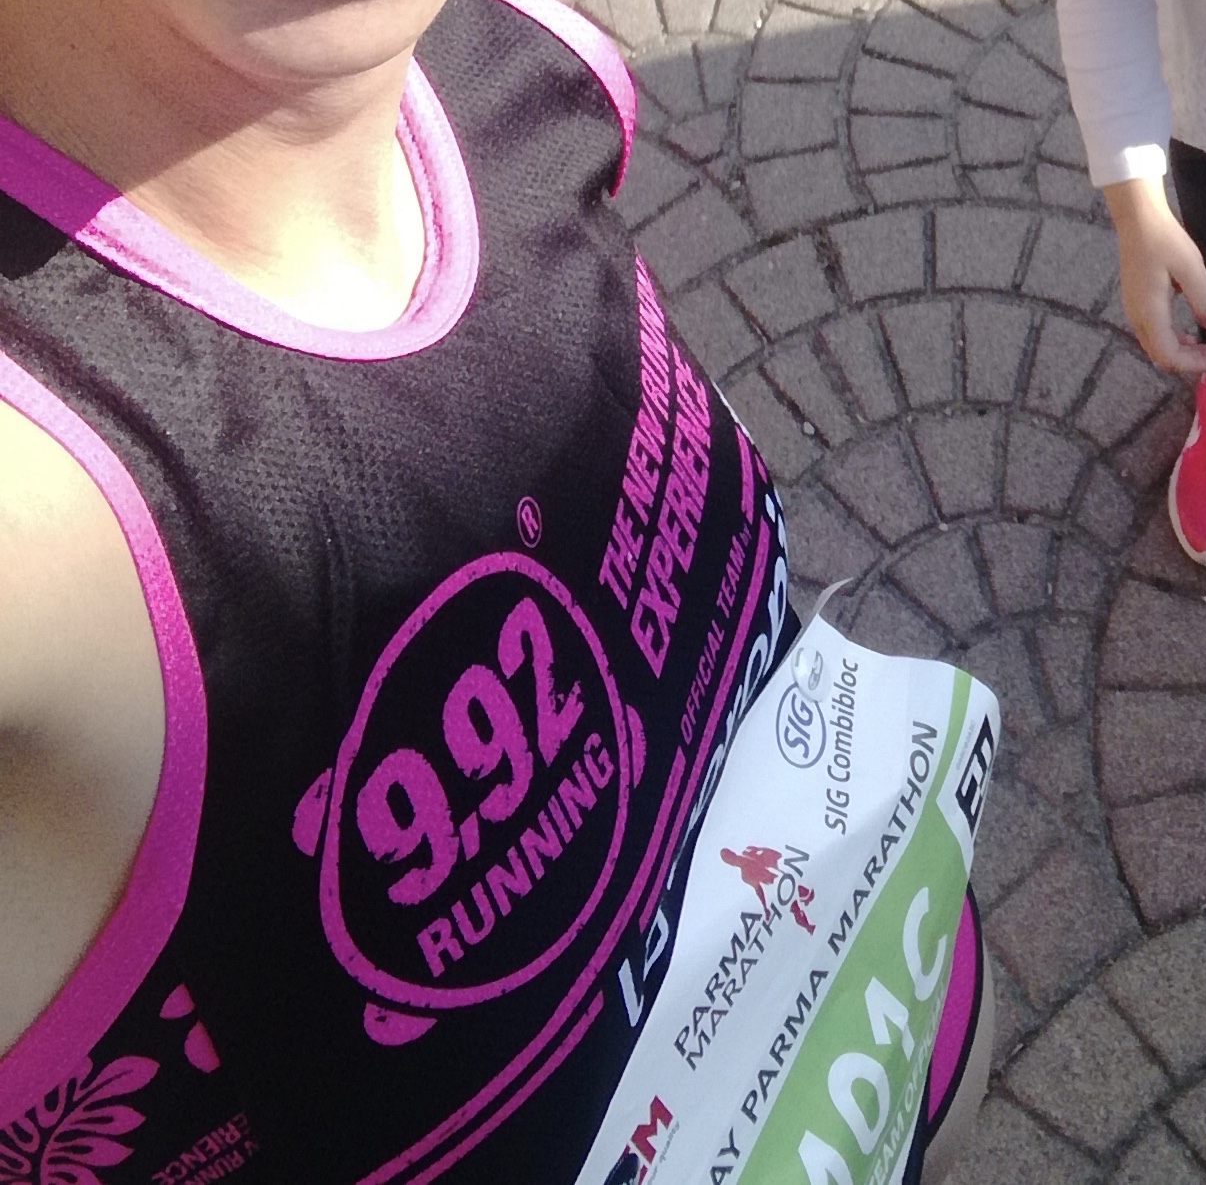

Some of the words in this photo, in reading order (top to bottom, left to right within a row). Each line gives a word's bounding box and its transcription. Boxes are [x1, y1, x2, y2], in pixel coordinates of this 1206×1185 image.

[634, 250, 669, 420] RUNNIN
[622, 406, 666, 526] NEW
[631, 343, 711, 679] EXPERIENCE
[600, 498, 644, 610] THE
[681, 619, 725, 744] OFFICIAL
[716, 536, 746, 618] TEAM
[828, 658, 859, 782] Combibloc
[356, 598, 585, 905] 9,92
[784, 693, 815, 759] SIG
[416, 733, 615, 977] RUNNING
[825, 788, 850, 835] SIG
[673, 910, 761, 1054] PARMA
[686, 845, 812, 1072] MARATHON
[741, 969, 829, 1121] PARMA
[828, 720, 938, 956] MARATHON
